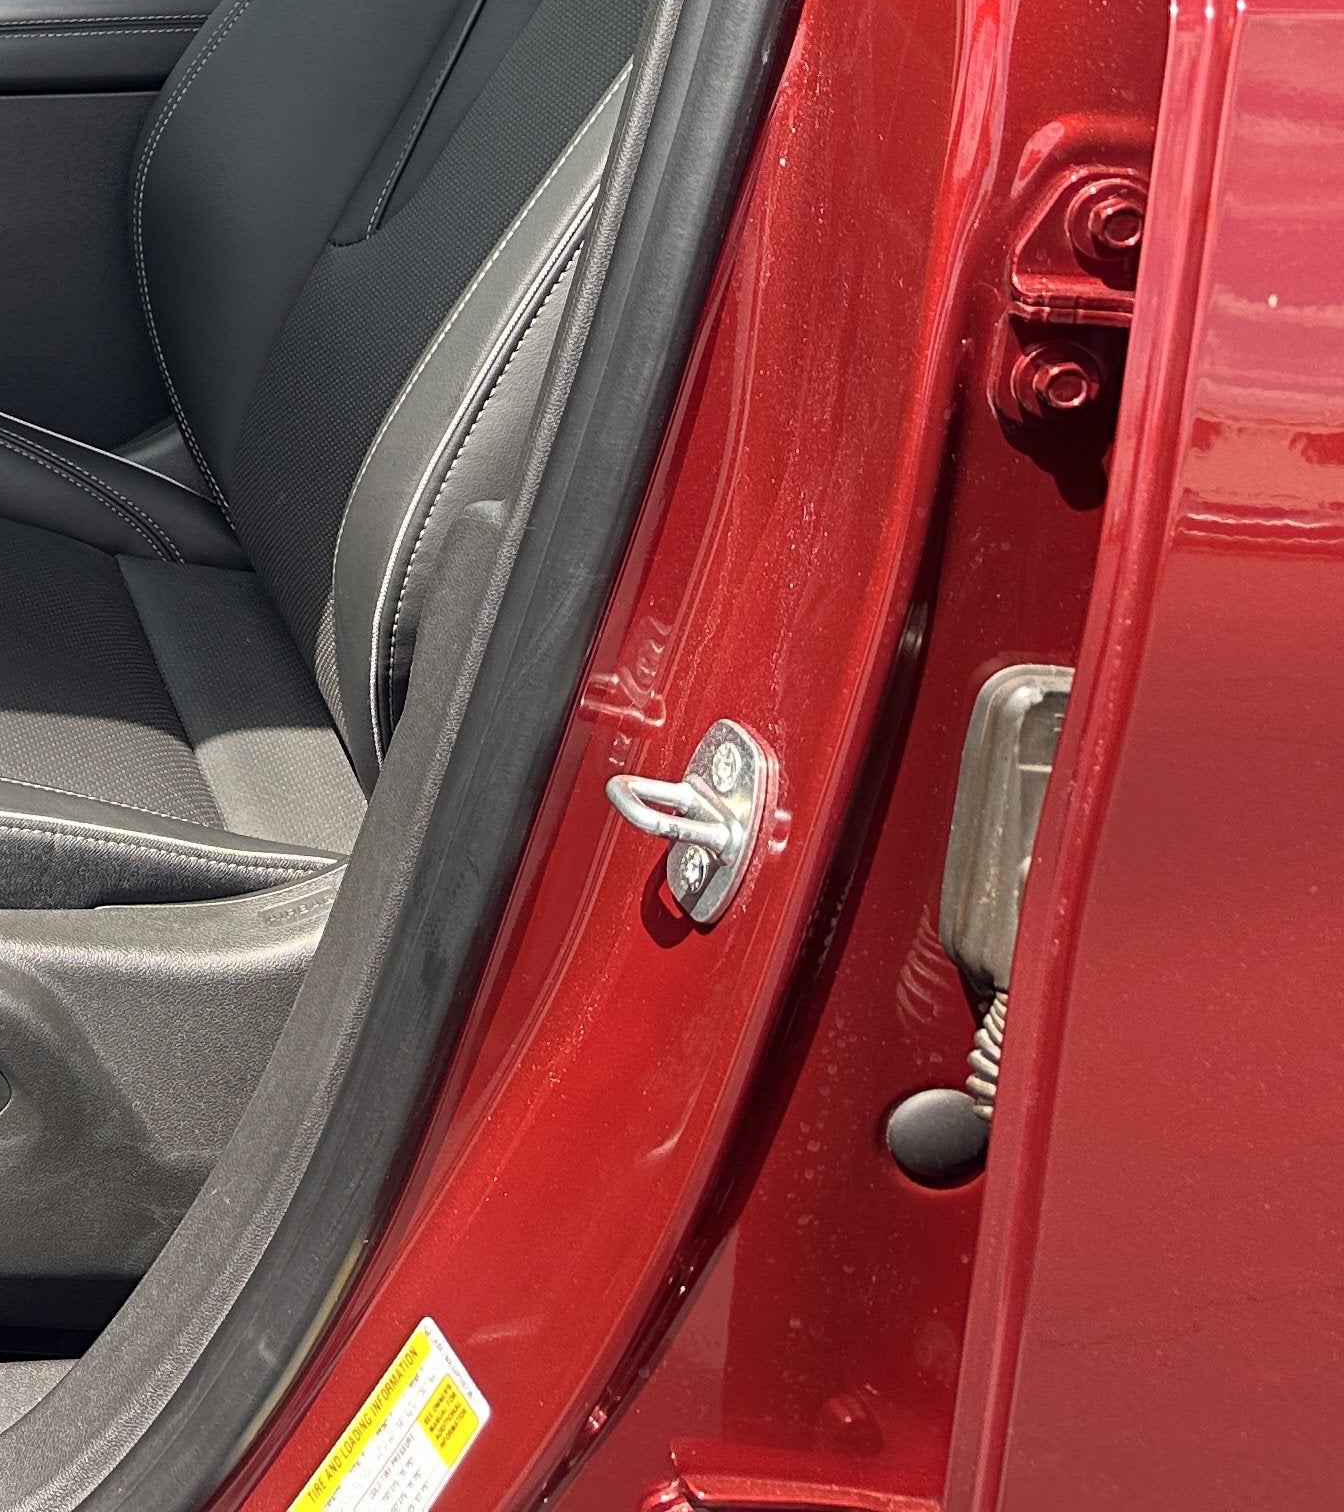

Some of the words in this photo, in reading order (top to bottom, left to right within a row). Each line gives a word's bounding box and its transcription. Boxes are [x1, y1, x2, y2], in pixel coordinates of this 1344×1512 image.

[307, 1480, 328, 1503] TIRE
[326, 1460, 343, 1486] AND
[344, 1413, 373, 1459] LOADING
[370, 1347, 418, 1417] INFORMATION
